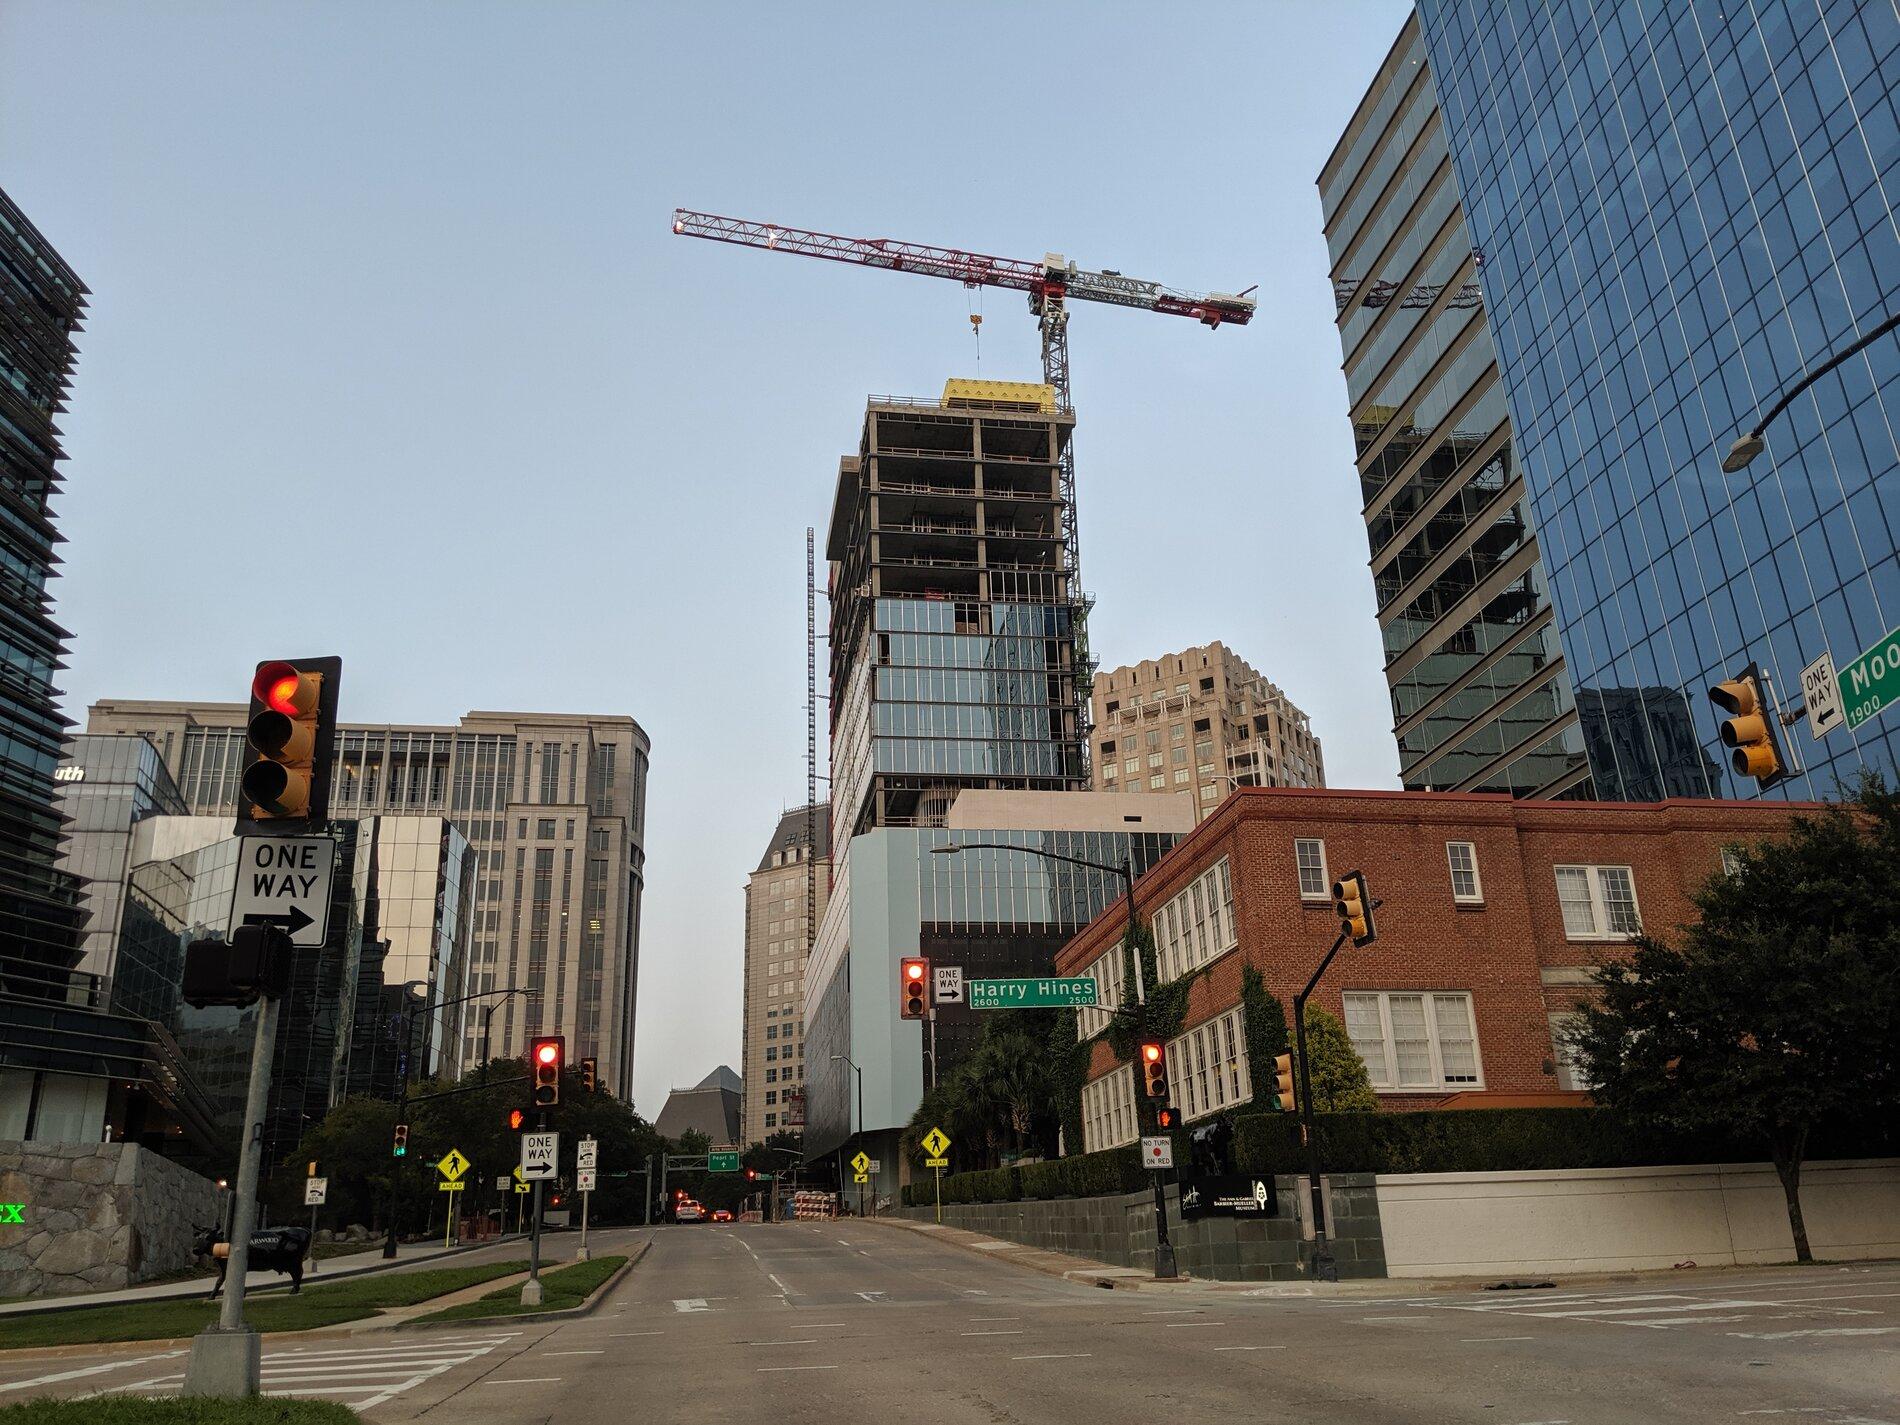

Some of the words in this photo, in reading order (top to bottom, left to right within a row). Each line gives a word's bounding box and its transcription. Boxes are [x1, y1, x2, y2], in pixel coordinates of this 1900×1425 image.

[1806, 664, 1829, 691] ONE
[1808, 681, 1832, 710] WAY
[1850, 695, 1880, 724] 1900
[255, 844, 318, 869] ONE
[253, 873, 319, 899] WAY
[939, 970, 957, 978] ONE
[939, 980, 959, 988] WAY
[974, 983, 1027, 999] Harry
[1039, 981, 1093, 996] Hines
[974, 998, 999, 1006] 2600
[1069, 996, 1095, 1004] 2500
[528, 1136, 552, 1148] ONE
[528, 1148, 552, 1160] WAY
[0, 1205, 26, 1222] X
